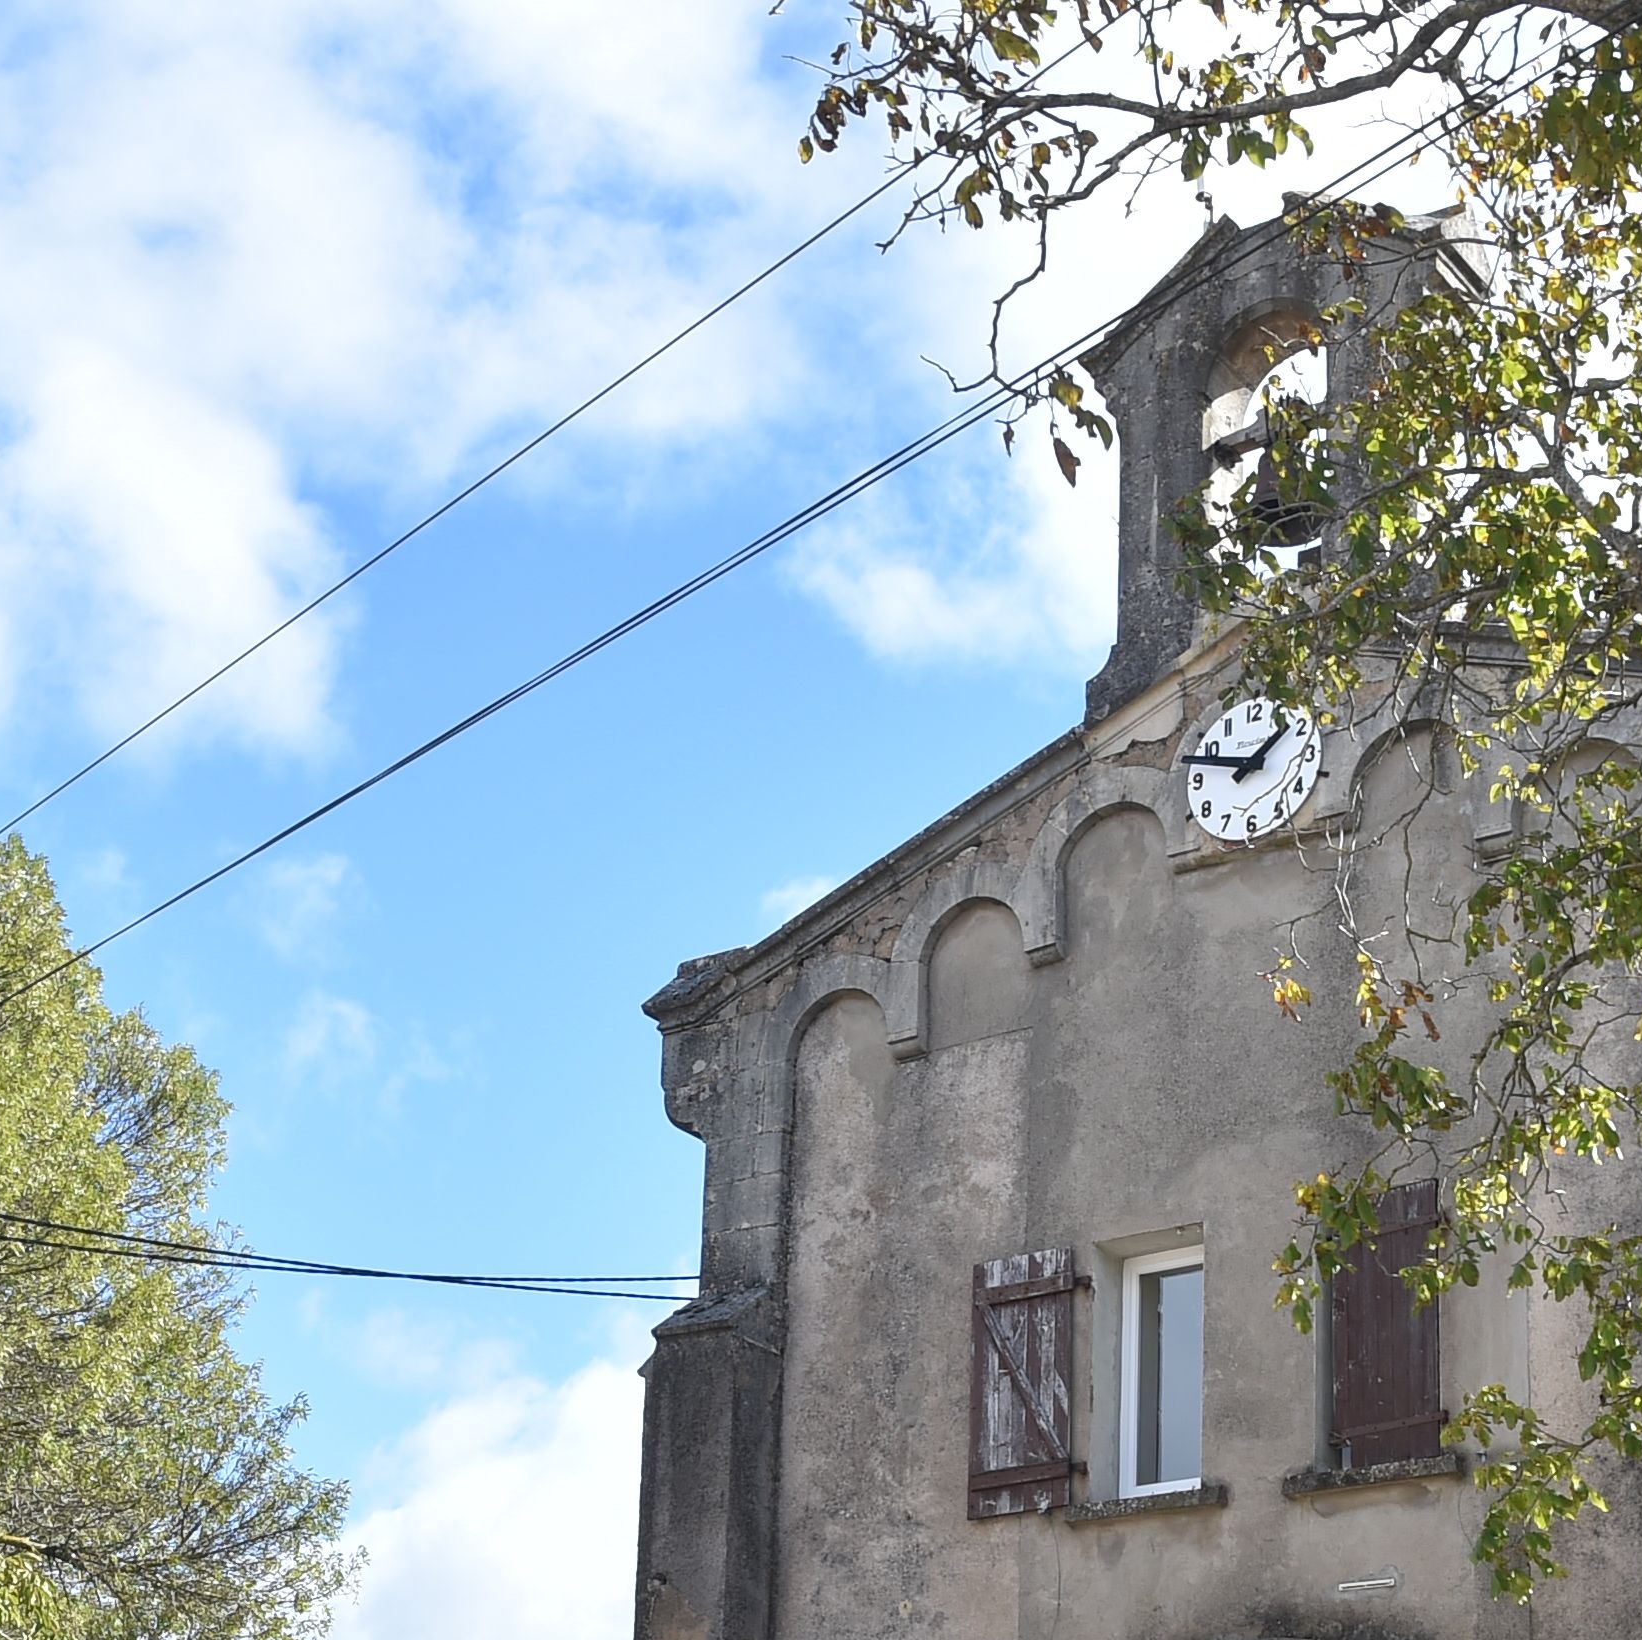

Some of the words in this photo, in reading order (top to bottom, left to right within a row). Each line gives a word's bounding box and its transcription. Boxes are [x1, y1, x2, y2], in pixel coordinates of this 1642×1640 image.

[1246, 703, 1263, 724] 12
[1224, 717, 1233, 737] 11
[1295, 717, 1307, 737] 2
[1205, 740, 1220, 758] 10
[1304, 744, 1316, 763] 3
[1193, 772, 1204, 791] 9
[1293, 775, 1304, 795] 4
[1201, 800, 1212, 819] 8
[1273, 801, 1284, 820] 5
[1220, 813, 1232, 833] 7
[1246, 814, 1258, 833] 6
